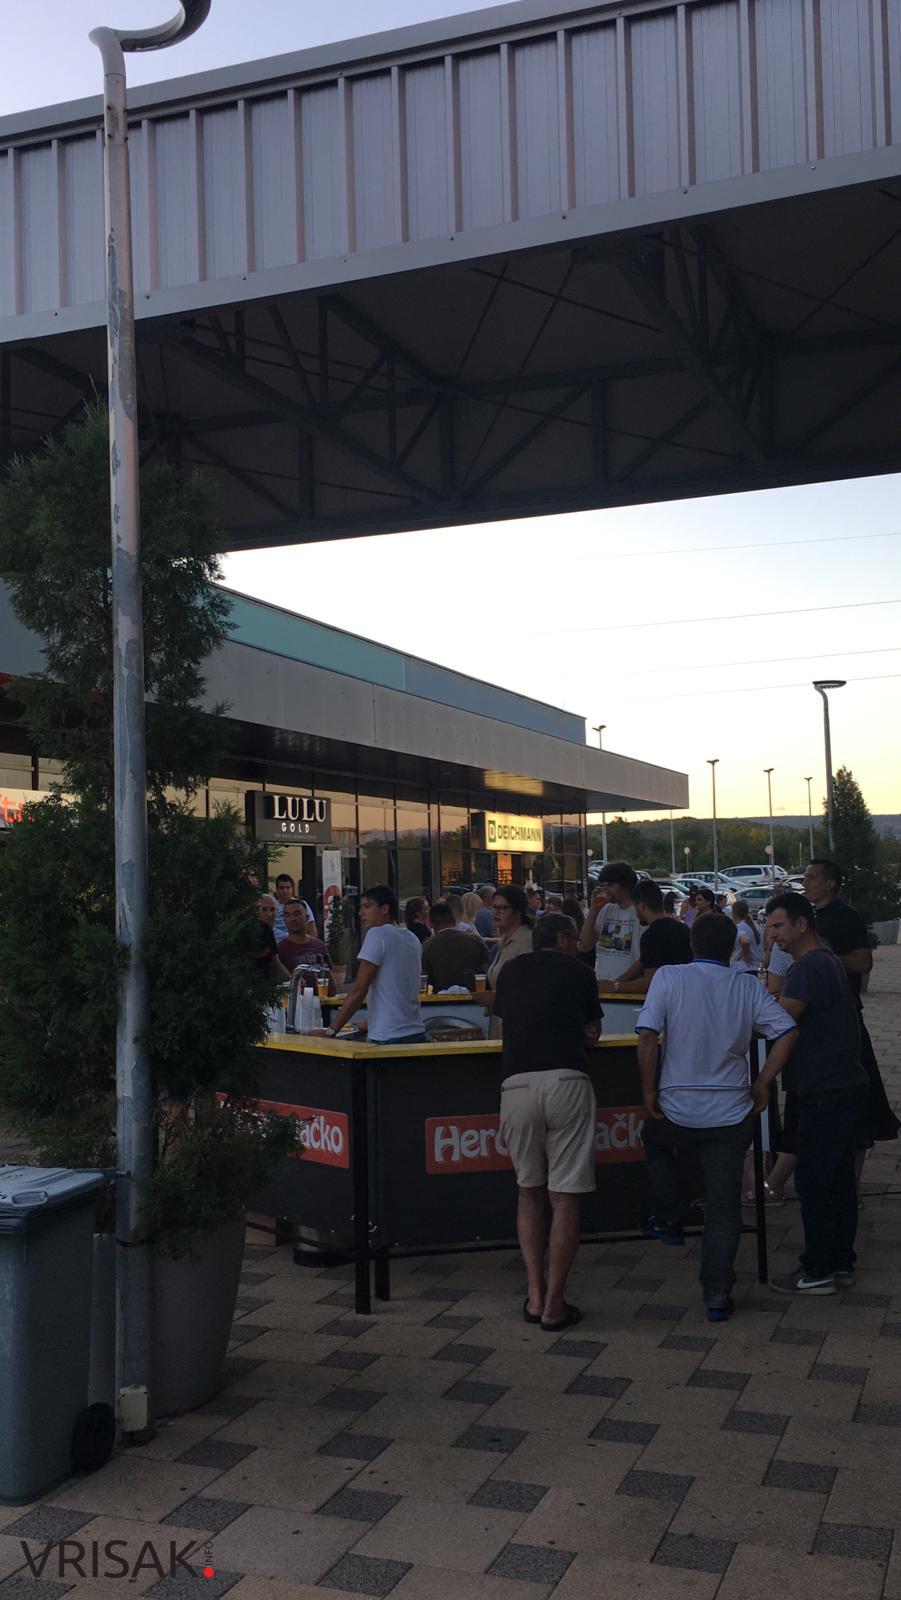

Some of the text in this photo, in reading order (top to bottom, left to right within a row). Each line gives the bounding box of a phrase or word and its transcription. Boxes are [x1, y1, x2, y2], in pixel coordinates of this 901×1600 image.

[273, 795, 326, 823] LULU
[281, 822, 310, 834] GOLD
[497, 824, 541, 841] DEICHMANN
